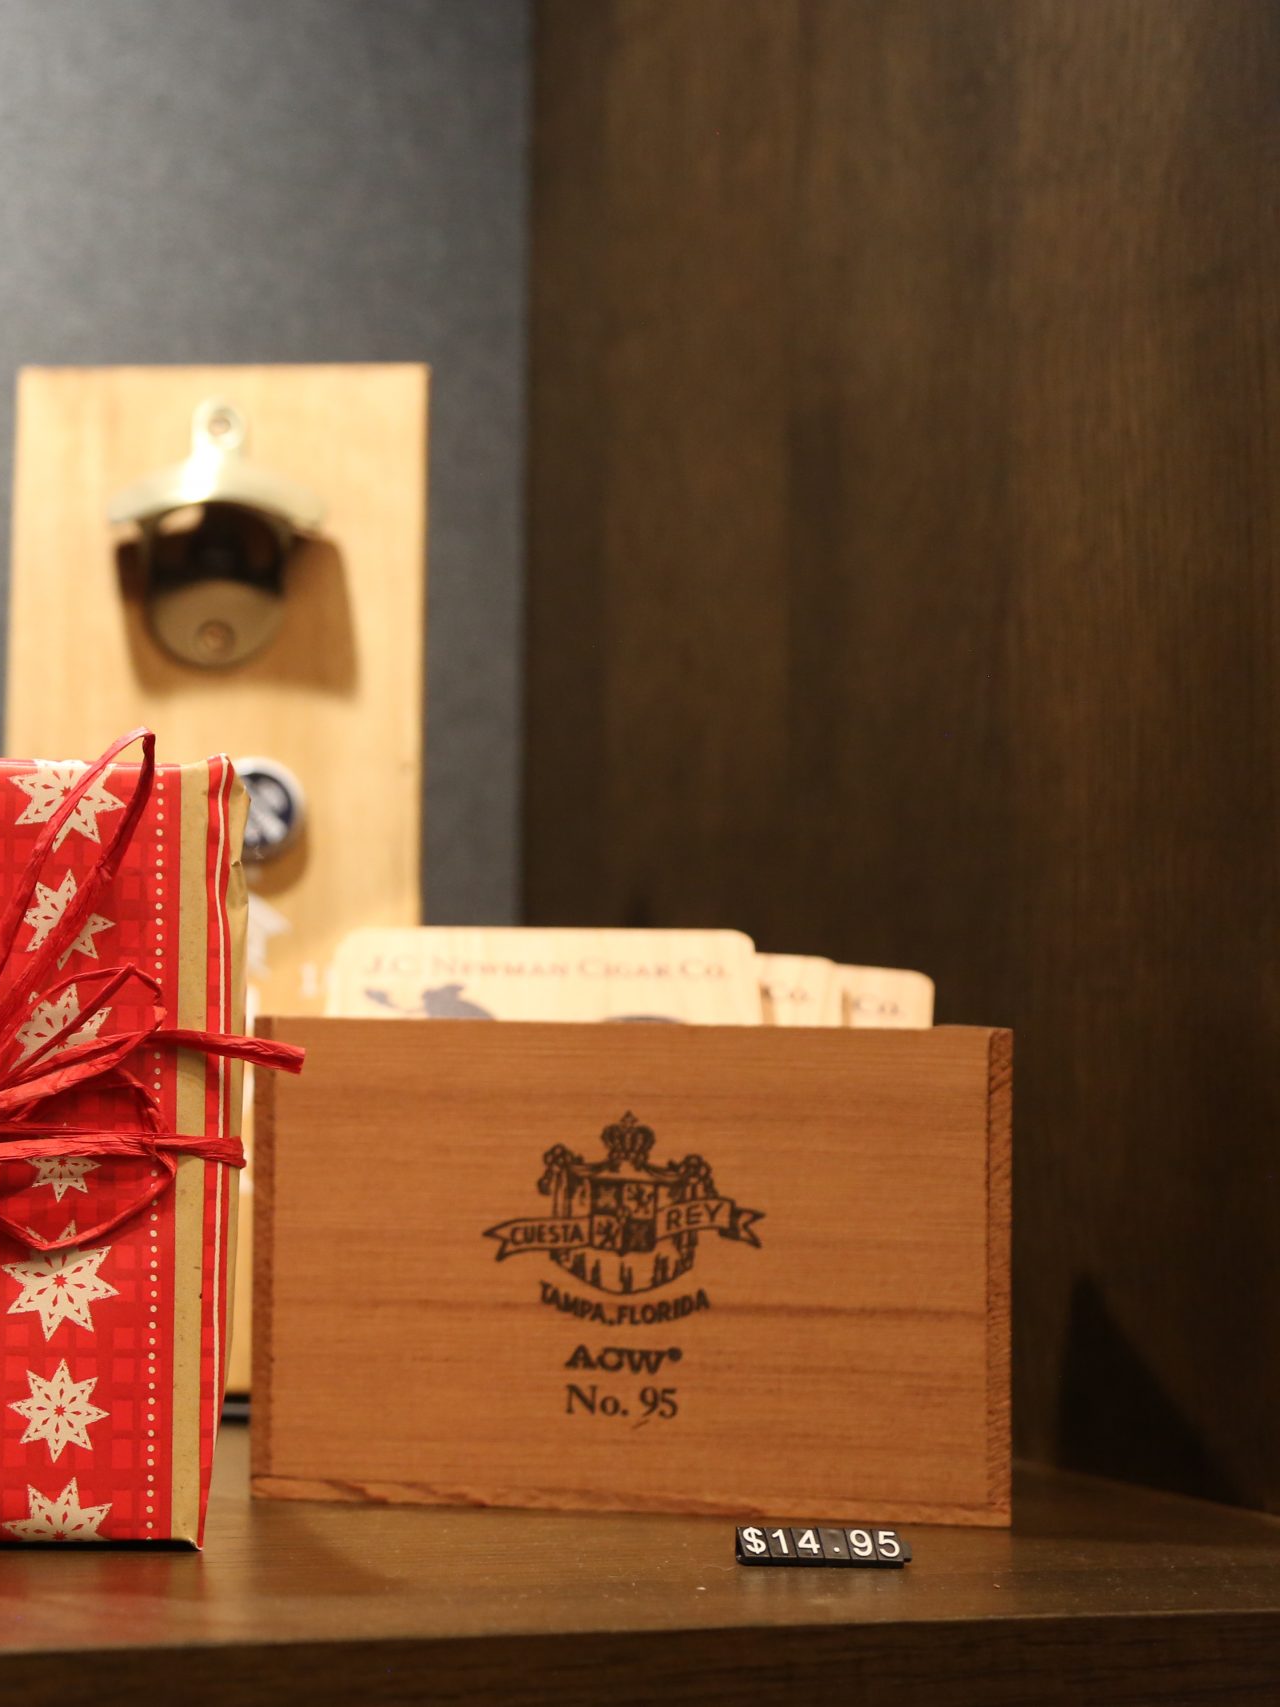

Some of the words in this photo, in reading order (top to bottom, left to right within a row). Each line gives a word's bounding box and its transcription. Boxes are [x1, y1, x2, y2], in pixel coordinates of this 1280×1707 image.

[510, 1223, 585, 1247] CUESTA
[666, 1203, 723, 1231] REY
[565, 1384, 629, 1417] No.
[638, 1386, 679, 1420] 95
[742, 1526, 901, 1558] $14.95
